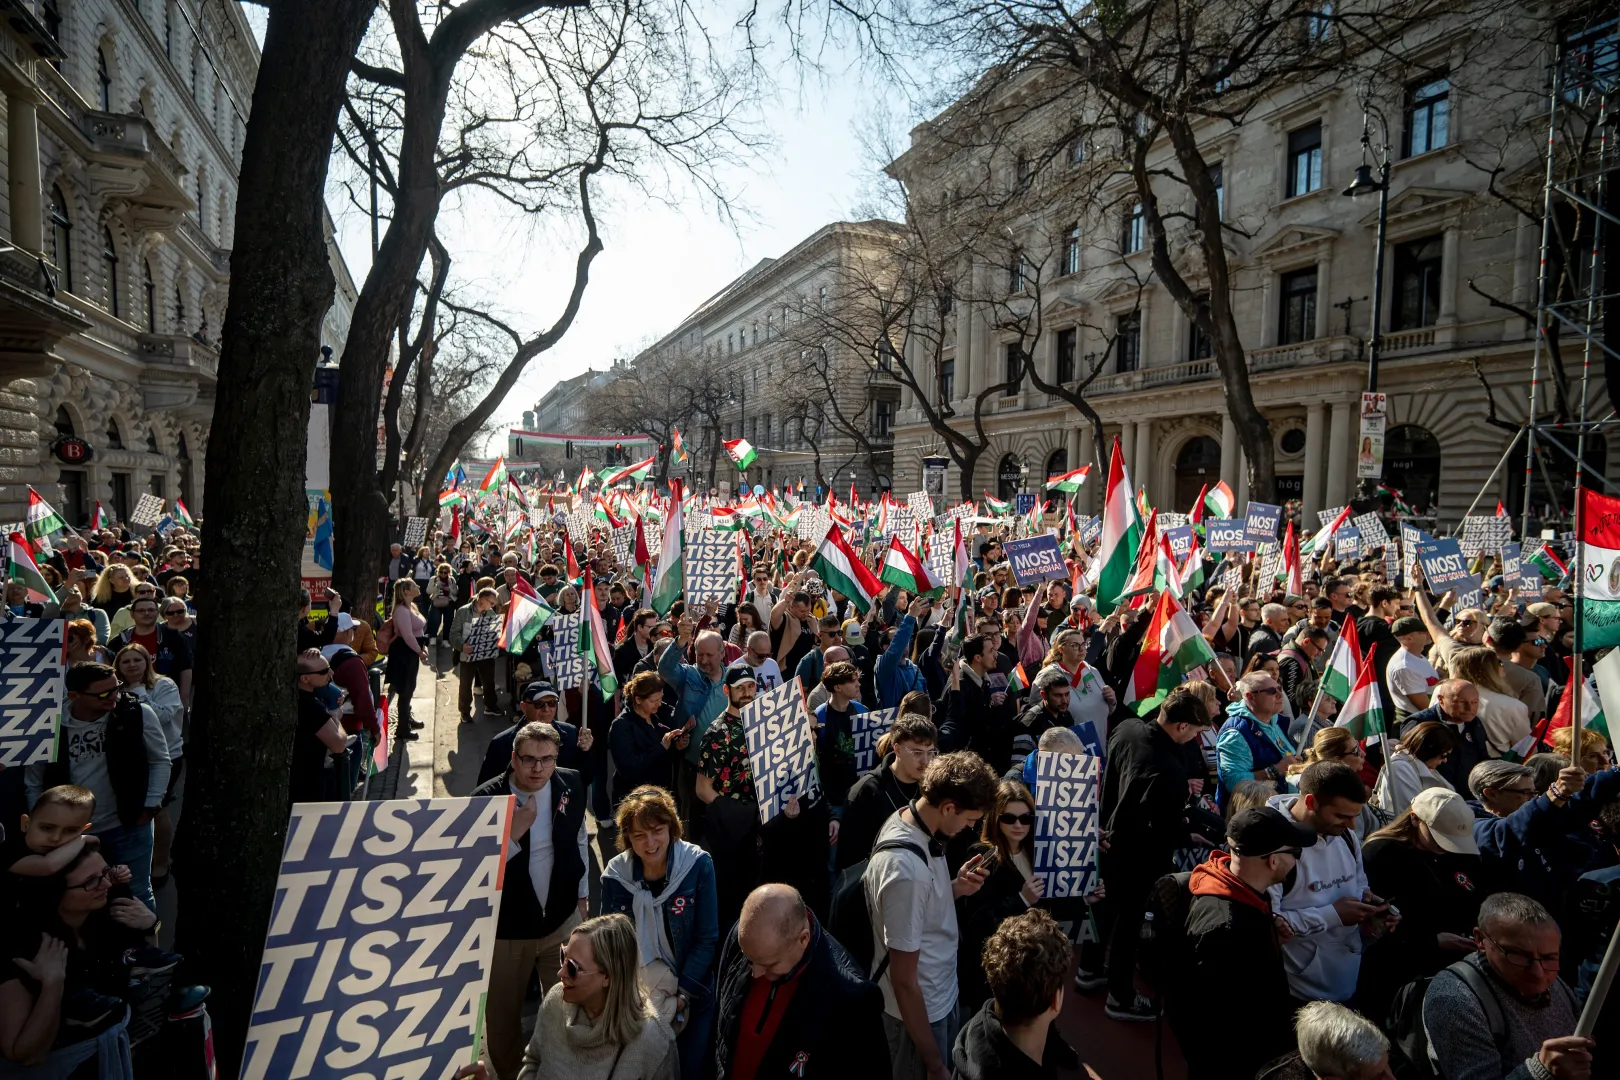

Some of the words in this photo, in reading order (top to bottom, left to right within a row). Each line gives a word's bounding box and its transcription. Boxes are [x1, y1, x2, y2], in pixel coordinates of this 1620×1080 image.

[68, 445, 80, 457] B
[1279, 480, 1300, 491] hög
[892, 507, 916, 518] TISZA
[1353, 511, 1377, 523] TISZA
[1465, 516, 1488, 524] TISZA
[1489, 516, 1511, 524] SZA
[892, 517, 916, 529] TISZA
[1247, 515, 1277, 530] MOST
[610, 533, 632, 545] TISZ
[687, 530, 738, 545] TISZA
[929, 530, 955, 546] TISZ
[1084, 522, 1100, 540] MOST
[1211, 529, 1243, 541] MOS
[1485, 532, 1511, 541] ISZA
[930, 542, 954, 556] TISZ
[1338, 536, 1358, 549] MOST
[686, 545, 738, 560] TISZA
[932, 554, 953, 567] TIS
[1014, 549, 1057, 570] MOST
[686, 560, 737, 575] TISZA
[935, 565, 952, 578] TIS
[1018, 567, 1039, 577] VAGY
[1039, 563, 1062, 574] SOHA!
[1425, 554, 1462, 575] MOST
[1504, 557, 1520, 573] MOST
[686, 576, 737, 590] TISZA
[1518, 577, 1538, 590] OST
[1454, 589, 1479, 613] MOST
[553, 612, 579, 629] TIS
[554, 627, 579, 645] TIS
[467, 650, 499, 662] TISZA
[555, 643, 579, 660] TIS
[0, 648, 61, 673] ZA
[556, 658, 583, 676] TIS
[557, 673, 583, 691] TIS
[740, 678, 803, 728] TISZA
[745, 699, 807, 753] TISZA
[850, 709, 895, 732] TISZ
[852, 727, 884, 751] TIS
[749, 722, 813, 777] TISZA
[754, 744, 814, 801] TISZA
[1038, 751, 1099, 780] TISZA
[1036, 780, 1098, 808] TISZA
[283, 795, 510, 863] TISZA
[1035, 810, 1097, 838] TISZA
[1034, 840, 1097, 868] TISZA
[268, 855, 501, 937] TISZA
[254, 915, 492, 1014] TISZA
[240, 980, 480, 1080] TISZA
